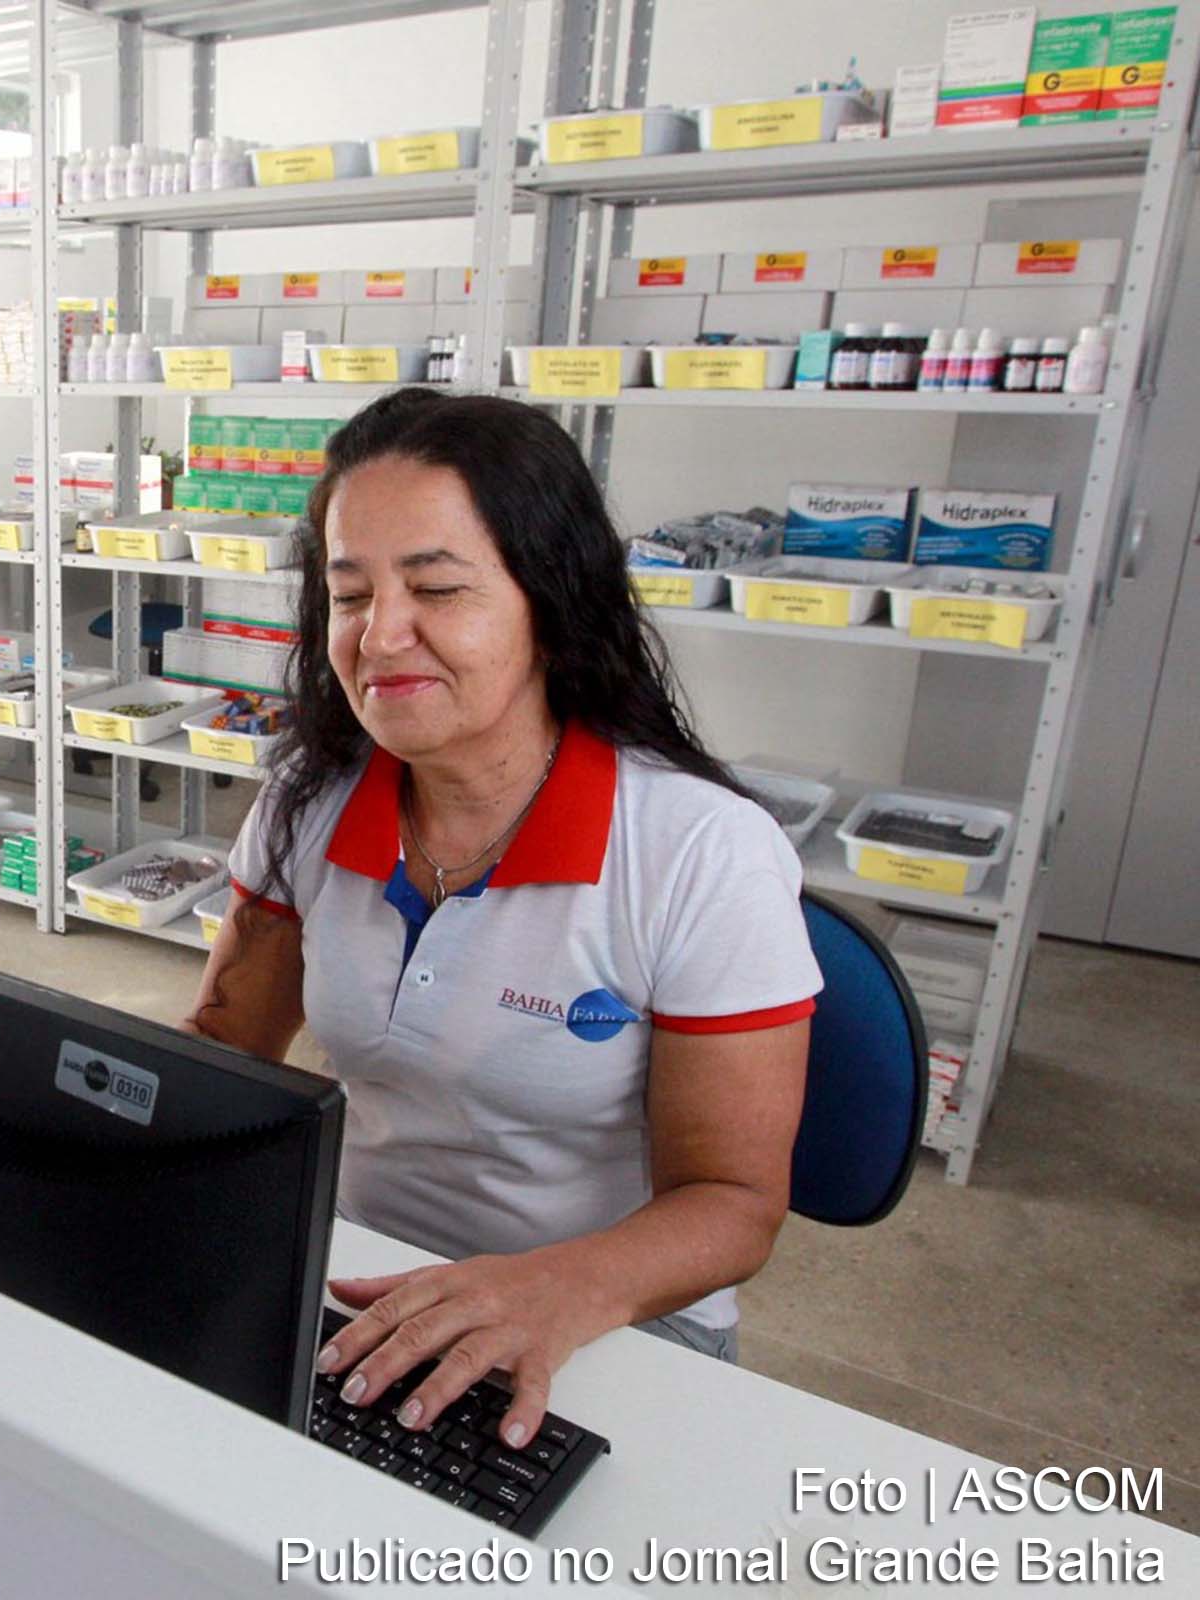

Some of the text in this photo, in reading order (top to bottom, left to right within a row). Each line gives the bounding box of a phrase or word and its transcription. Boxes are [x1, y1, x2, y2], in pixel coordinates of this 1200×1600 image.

[1043, 73, 1060, 91] G
[1121, 66, 1139, 85] G
[807, 495, 885, 513] Hidraplex
[942, 503, 1028, 522] Hidraplex
[501, 987, 565, 1018] BAHIA
[116, 1079, 148, 1103] 0310
